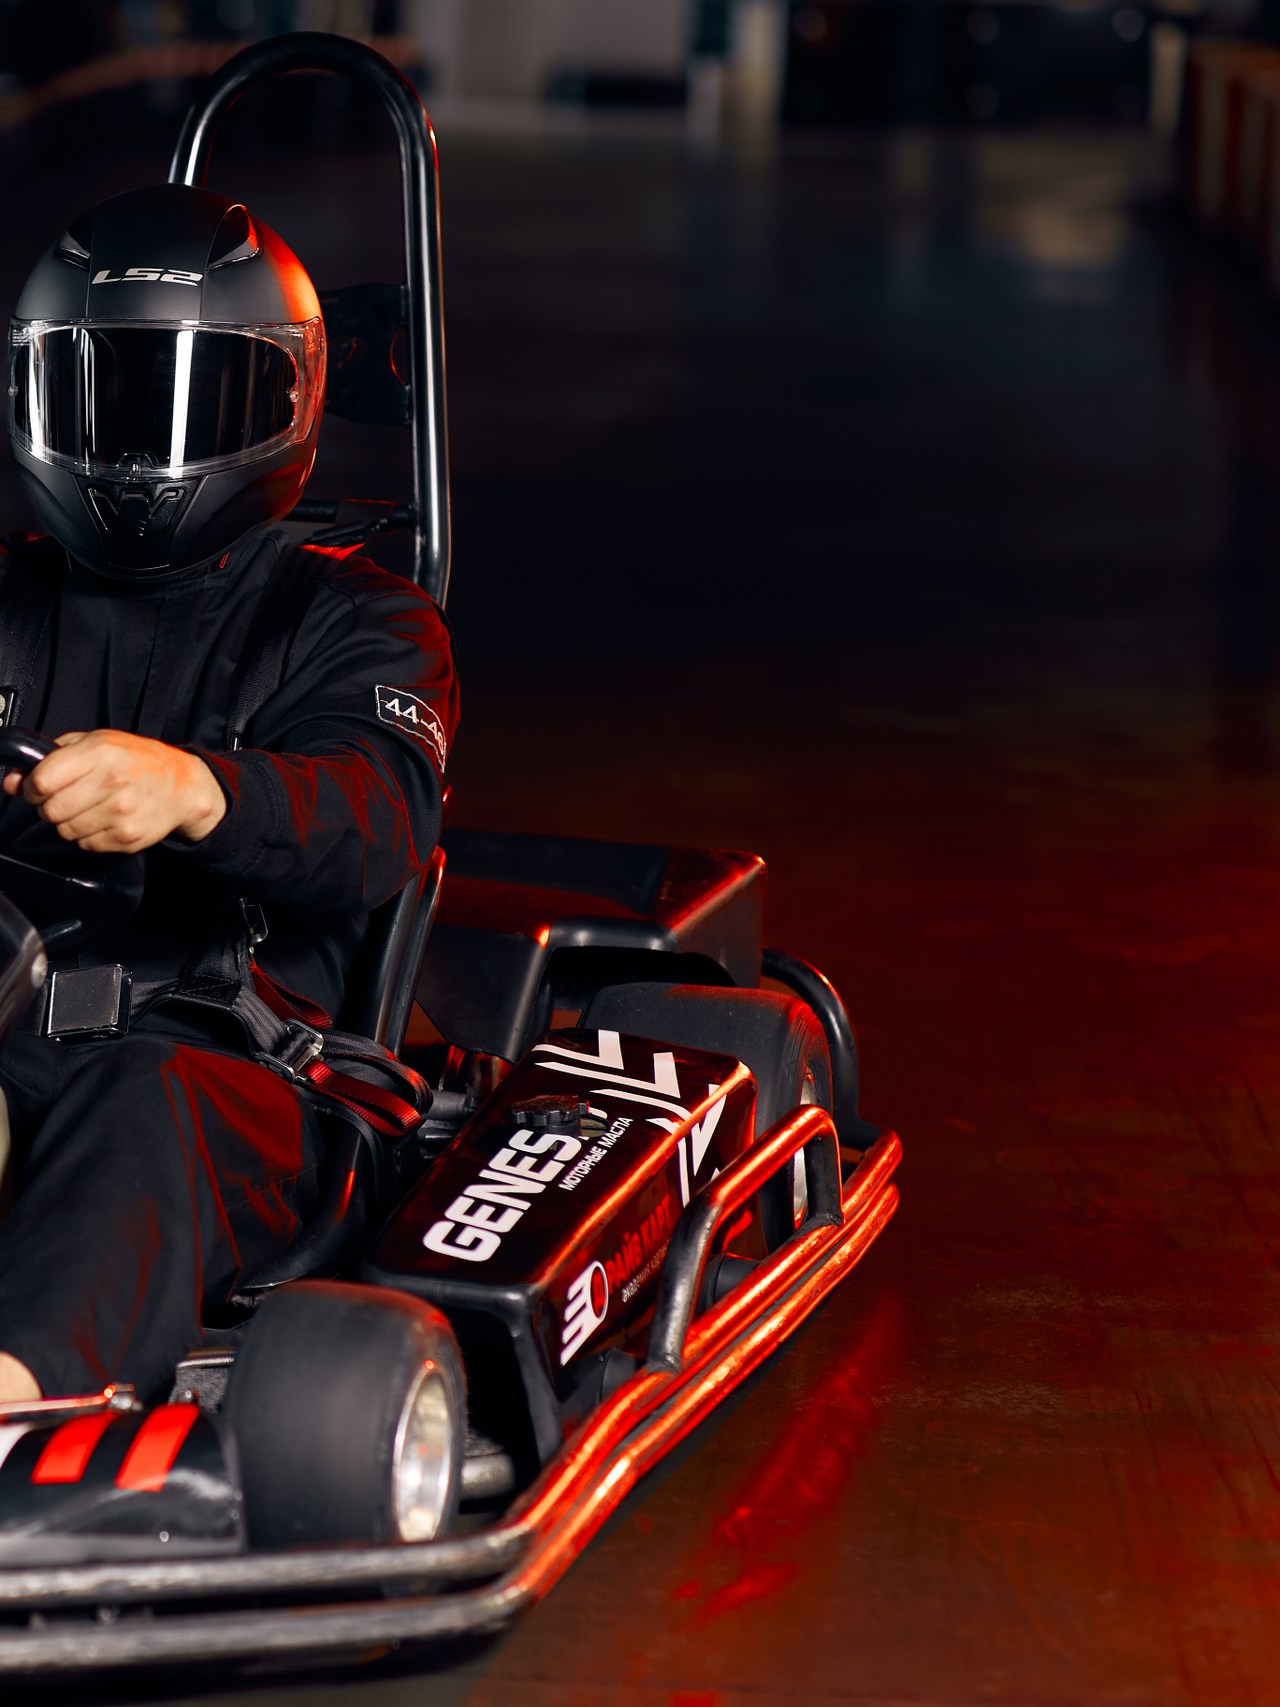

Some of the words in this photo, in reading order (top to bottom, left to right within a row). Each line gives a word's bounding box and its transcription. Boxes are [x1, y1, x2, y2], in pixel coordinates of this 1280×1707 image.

[91, 267, 204, 287] LS2
[422, 1104, 609, 1263] GENES
[558, 1145, 608, 1192] МОТОРНЫЕ
